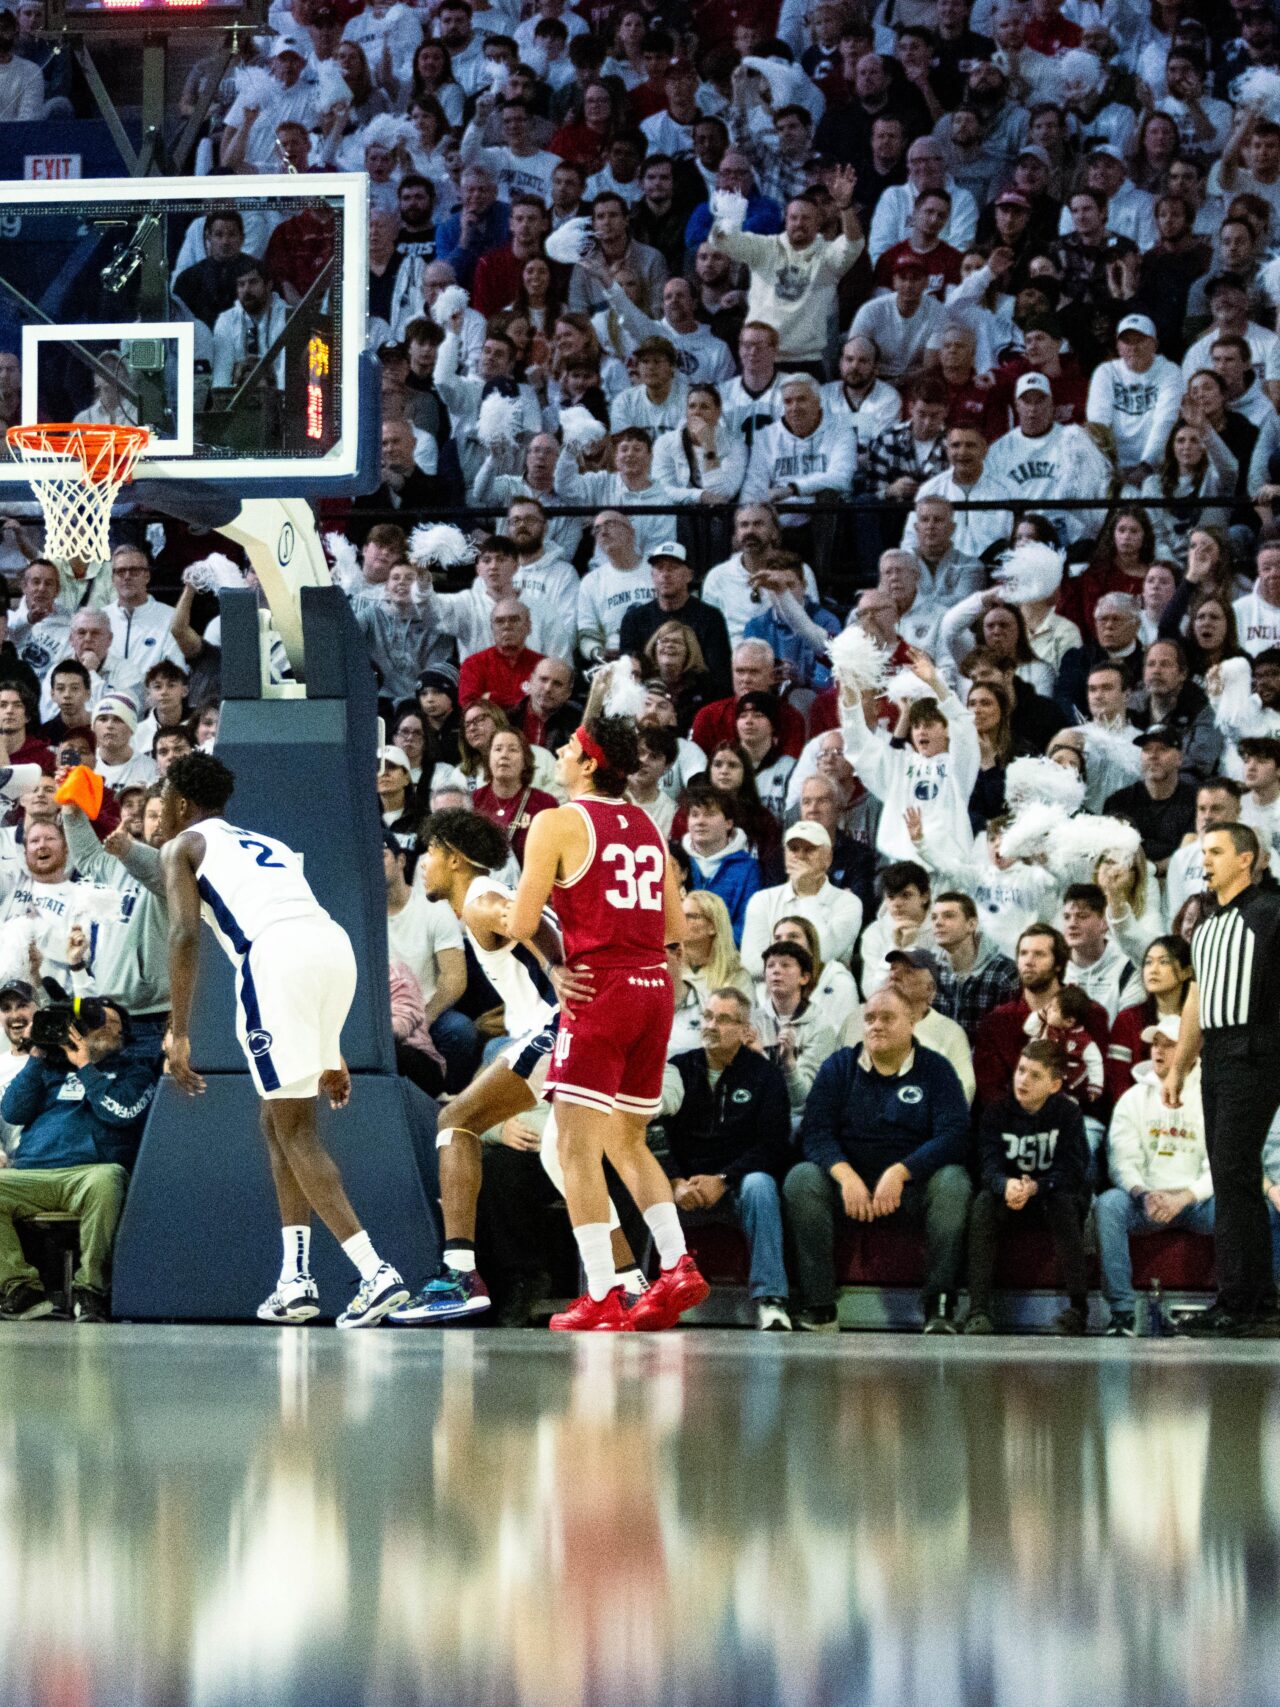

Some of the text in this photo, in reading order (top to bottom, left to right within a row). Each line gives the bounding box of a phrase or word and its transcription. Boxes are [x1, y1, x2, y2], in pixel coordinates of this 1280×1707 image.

[32, 158, 72, 180] EXIT
[607, 590, 632, 610] PENN
[238, 839, 287, 868] 2
[600, 843, 665, 912] 32
[34, 896, 65, 917] STATE
[1000, 1128, 1058, 1173] PSU
